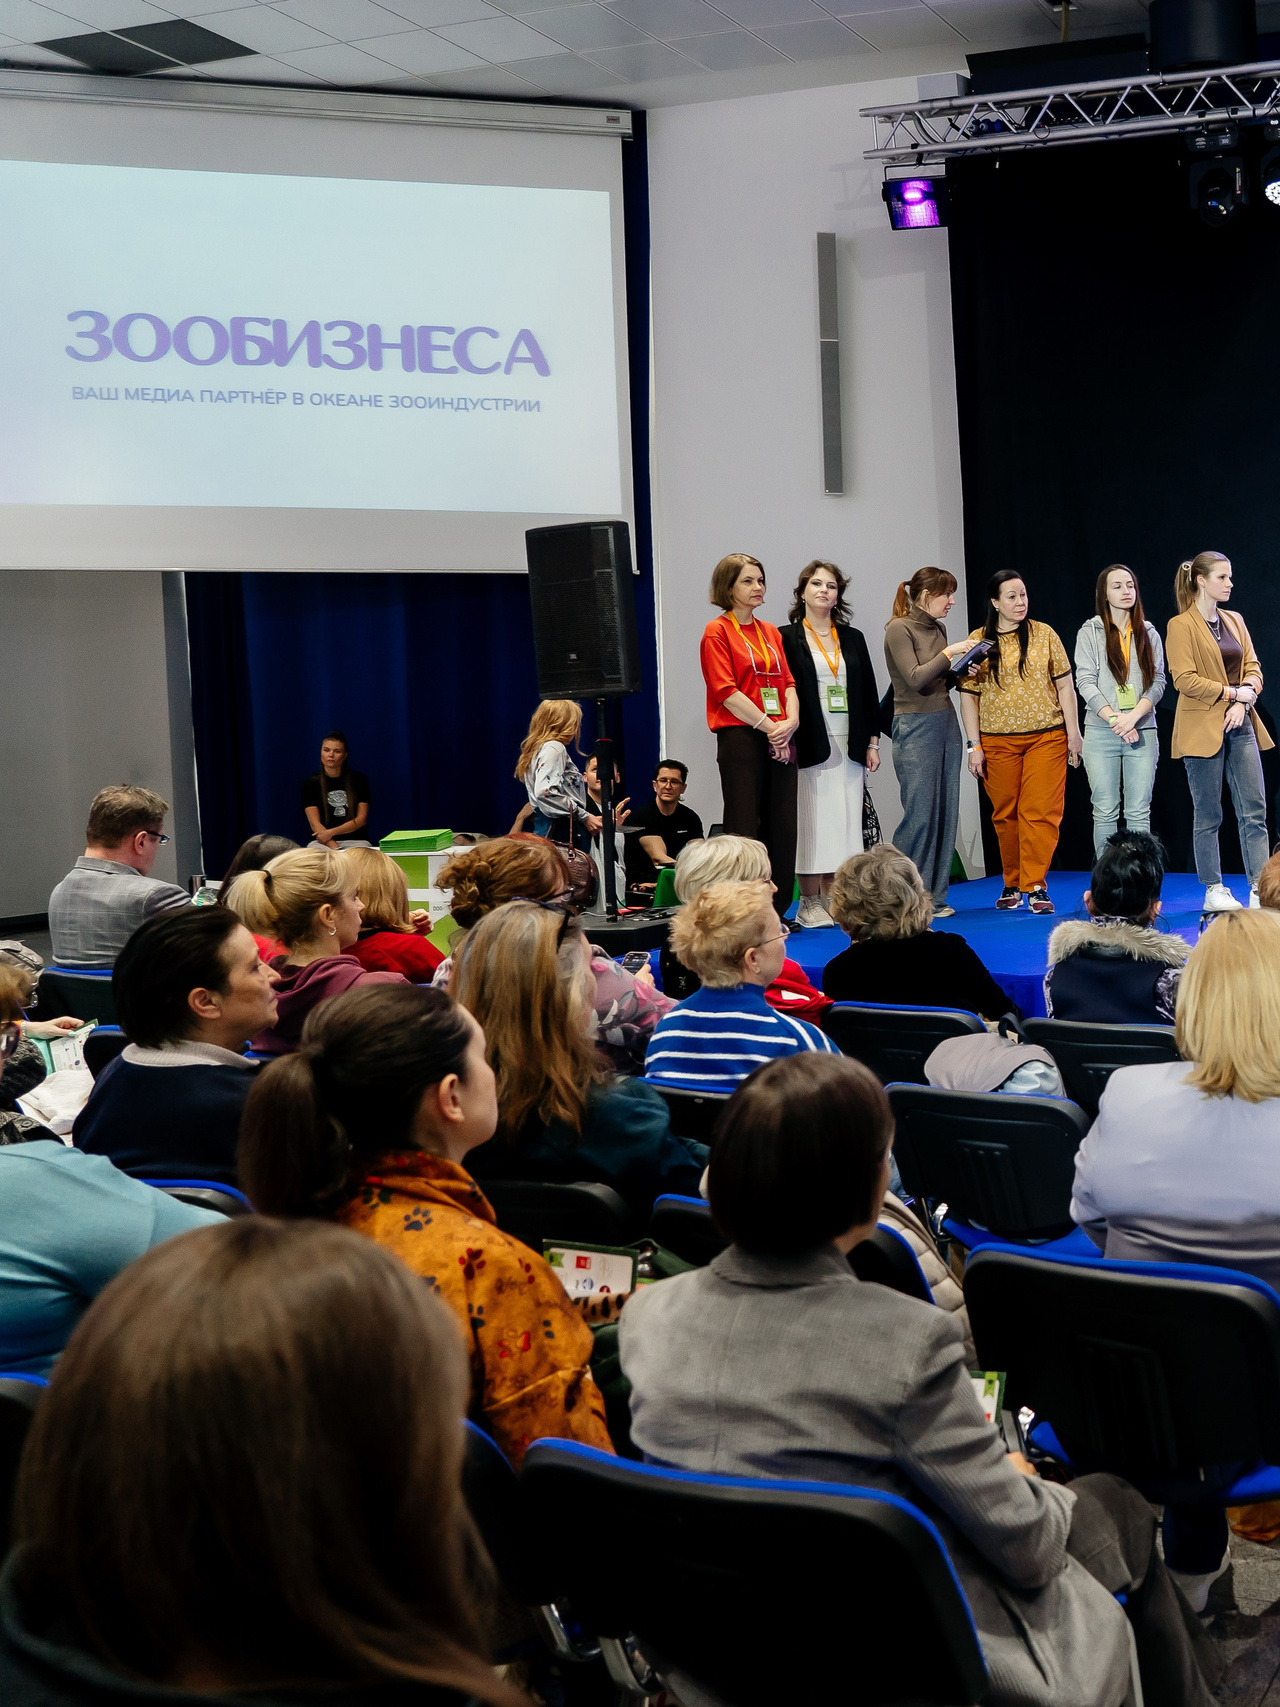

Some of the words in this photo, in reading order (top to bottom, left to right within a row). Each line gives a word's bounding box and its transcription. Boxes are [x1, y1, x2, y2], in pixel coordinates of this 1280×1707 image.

[65, 310, 551, 377] ЗООБИЗНЕСА
[72, 386, 119, 401] ВАШ
[124, 387, 195, 404] МЕДИА
[200, 388, 287, 405] ПАРТНЁР
[292, 392, 304, 405] В
[309, 392, 383, 408] ОКЕАНЕ
[389, 395, 541, 412] ЗООИНДУСТРИИ
